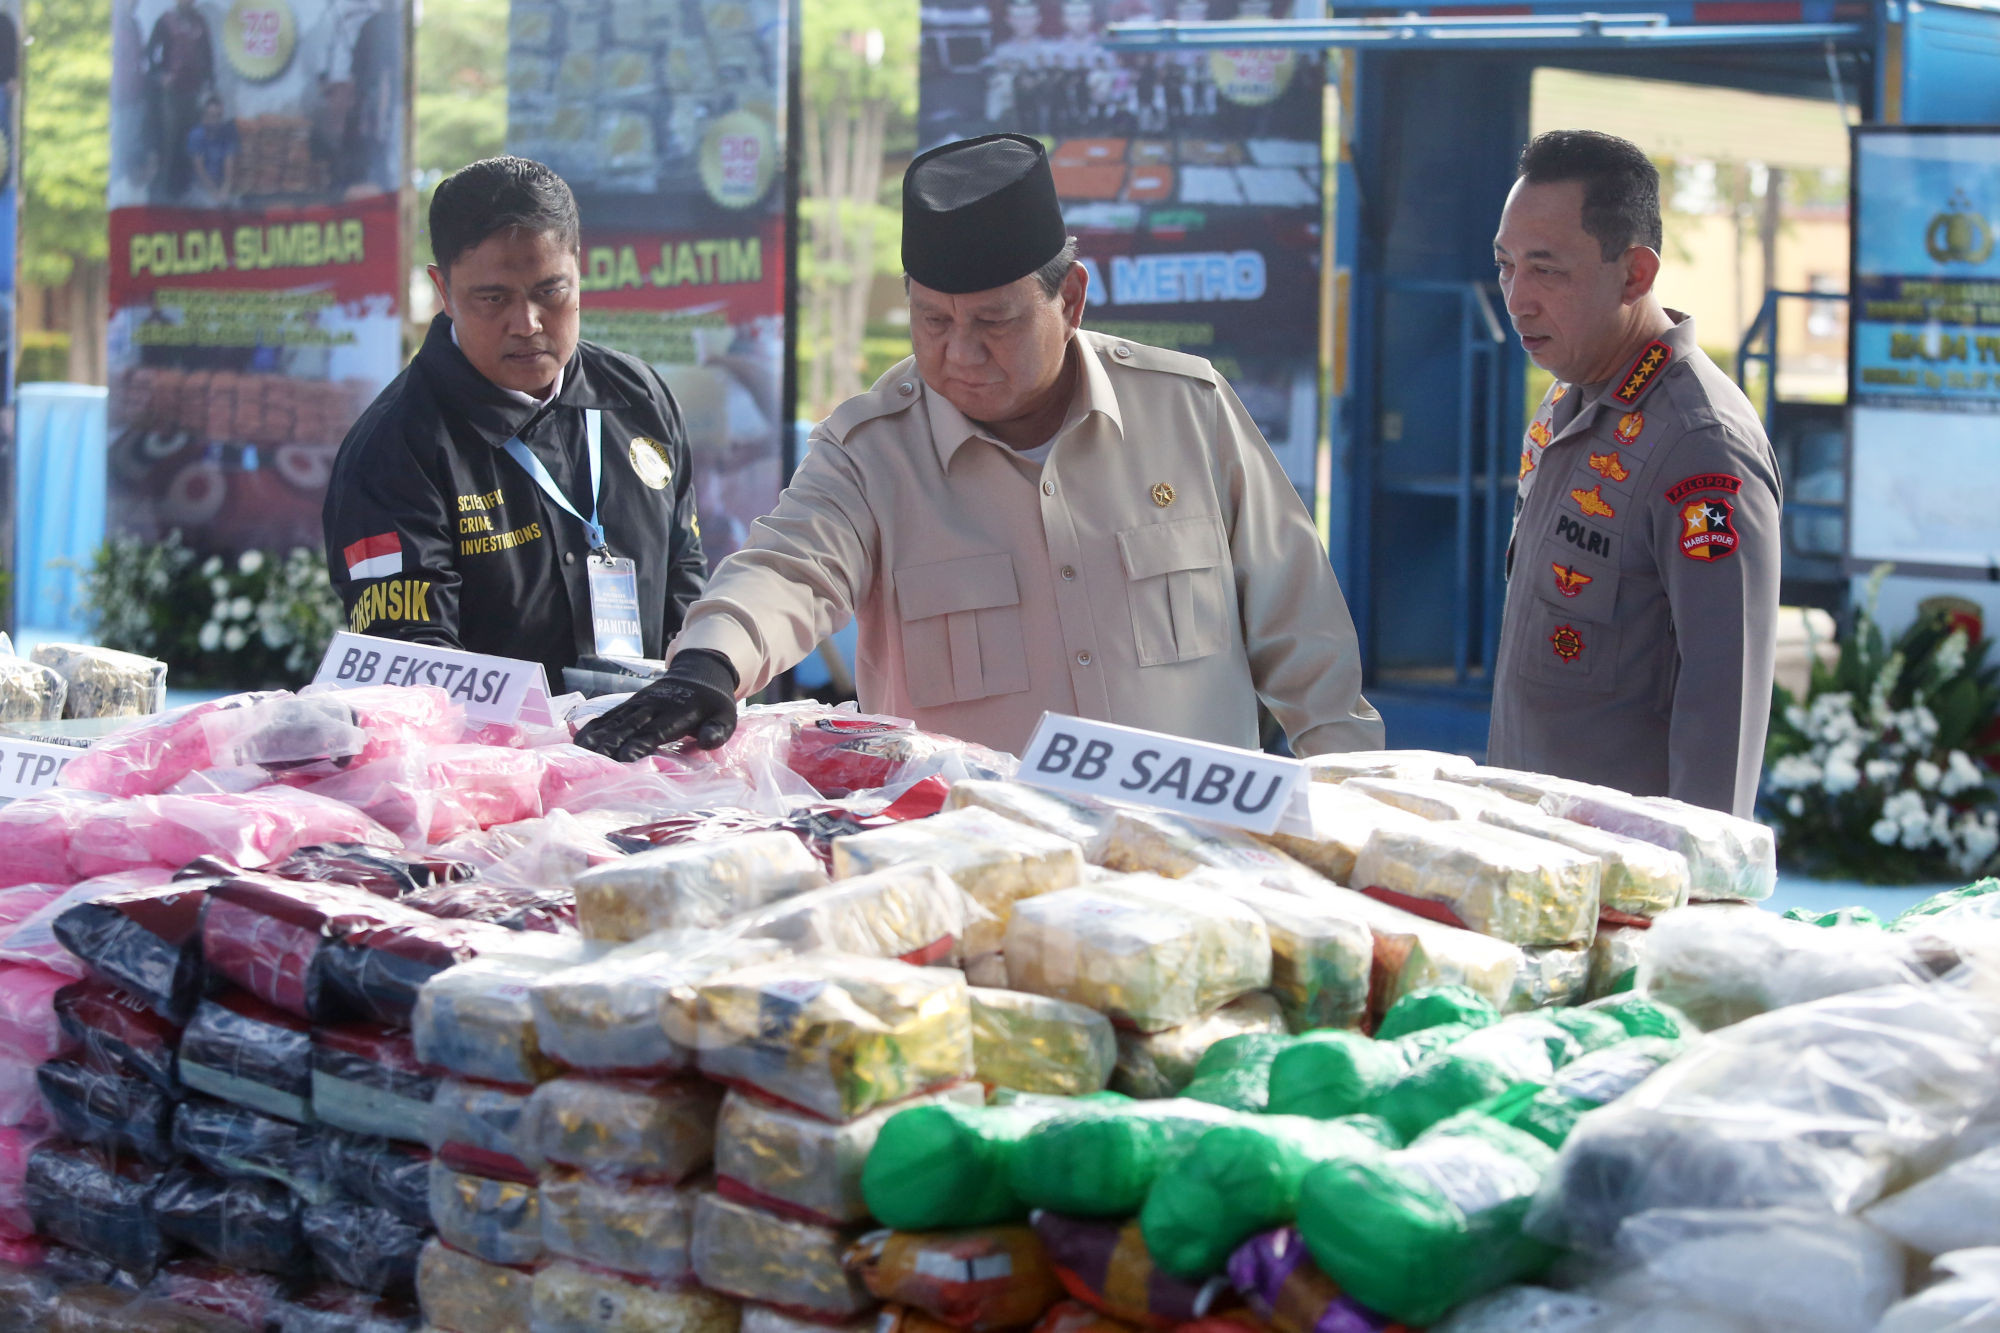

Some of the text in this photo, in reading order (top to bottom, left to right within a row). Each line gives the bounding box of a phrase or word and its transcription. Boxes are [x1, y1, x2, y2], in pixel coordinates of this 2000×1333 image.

[130, 219, 364, 277] POLDA SUMBAR
[651, 237, 762, 287] JATIM
[1110, 249, 1267, 306] METRO
[1670, 476, 1735, 500] PELOPOR
[460, 515, 494, 534] CRIME
[461, 522, 542, 556] INVESTIIONS
[1555, 514, 1611, 559] POLRI
[1683, 534, 1734, 549] MABES POLRI
[597, 619, 639, 635] PANITIA
[336, 647, 511, 705] BB EKSTASI
[1036, 732, 1283, 814] BB SABU
